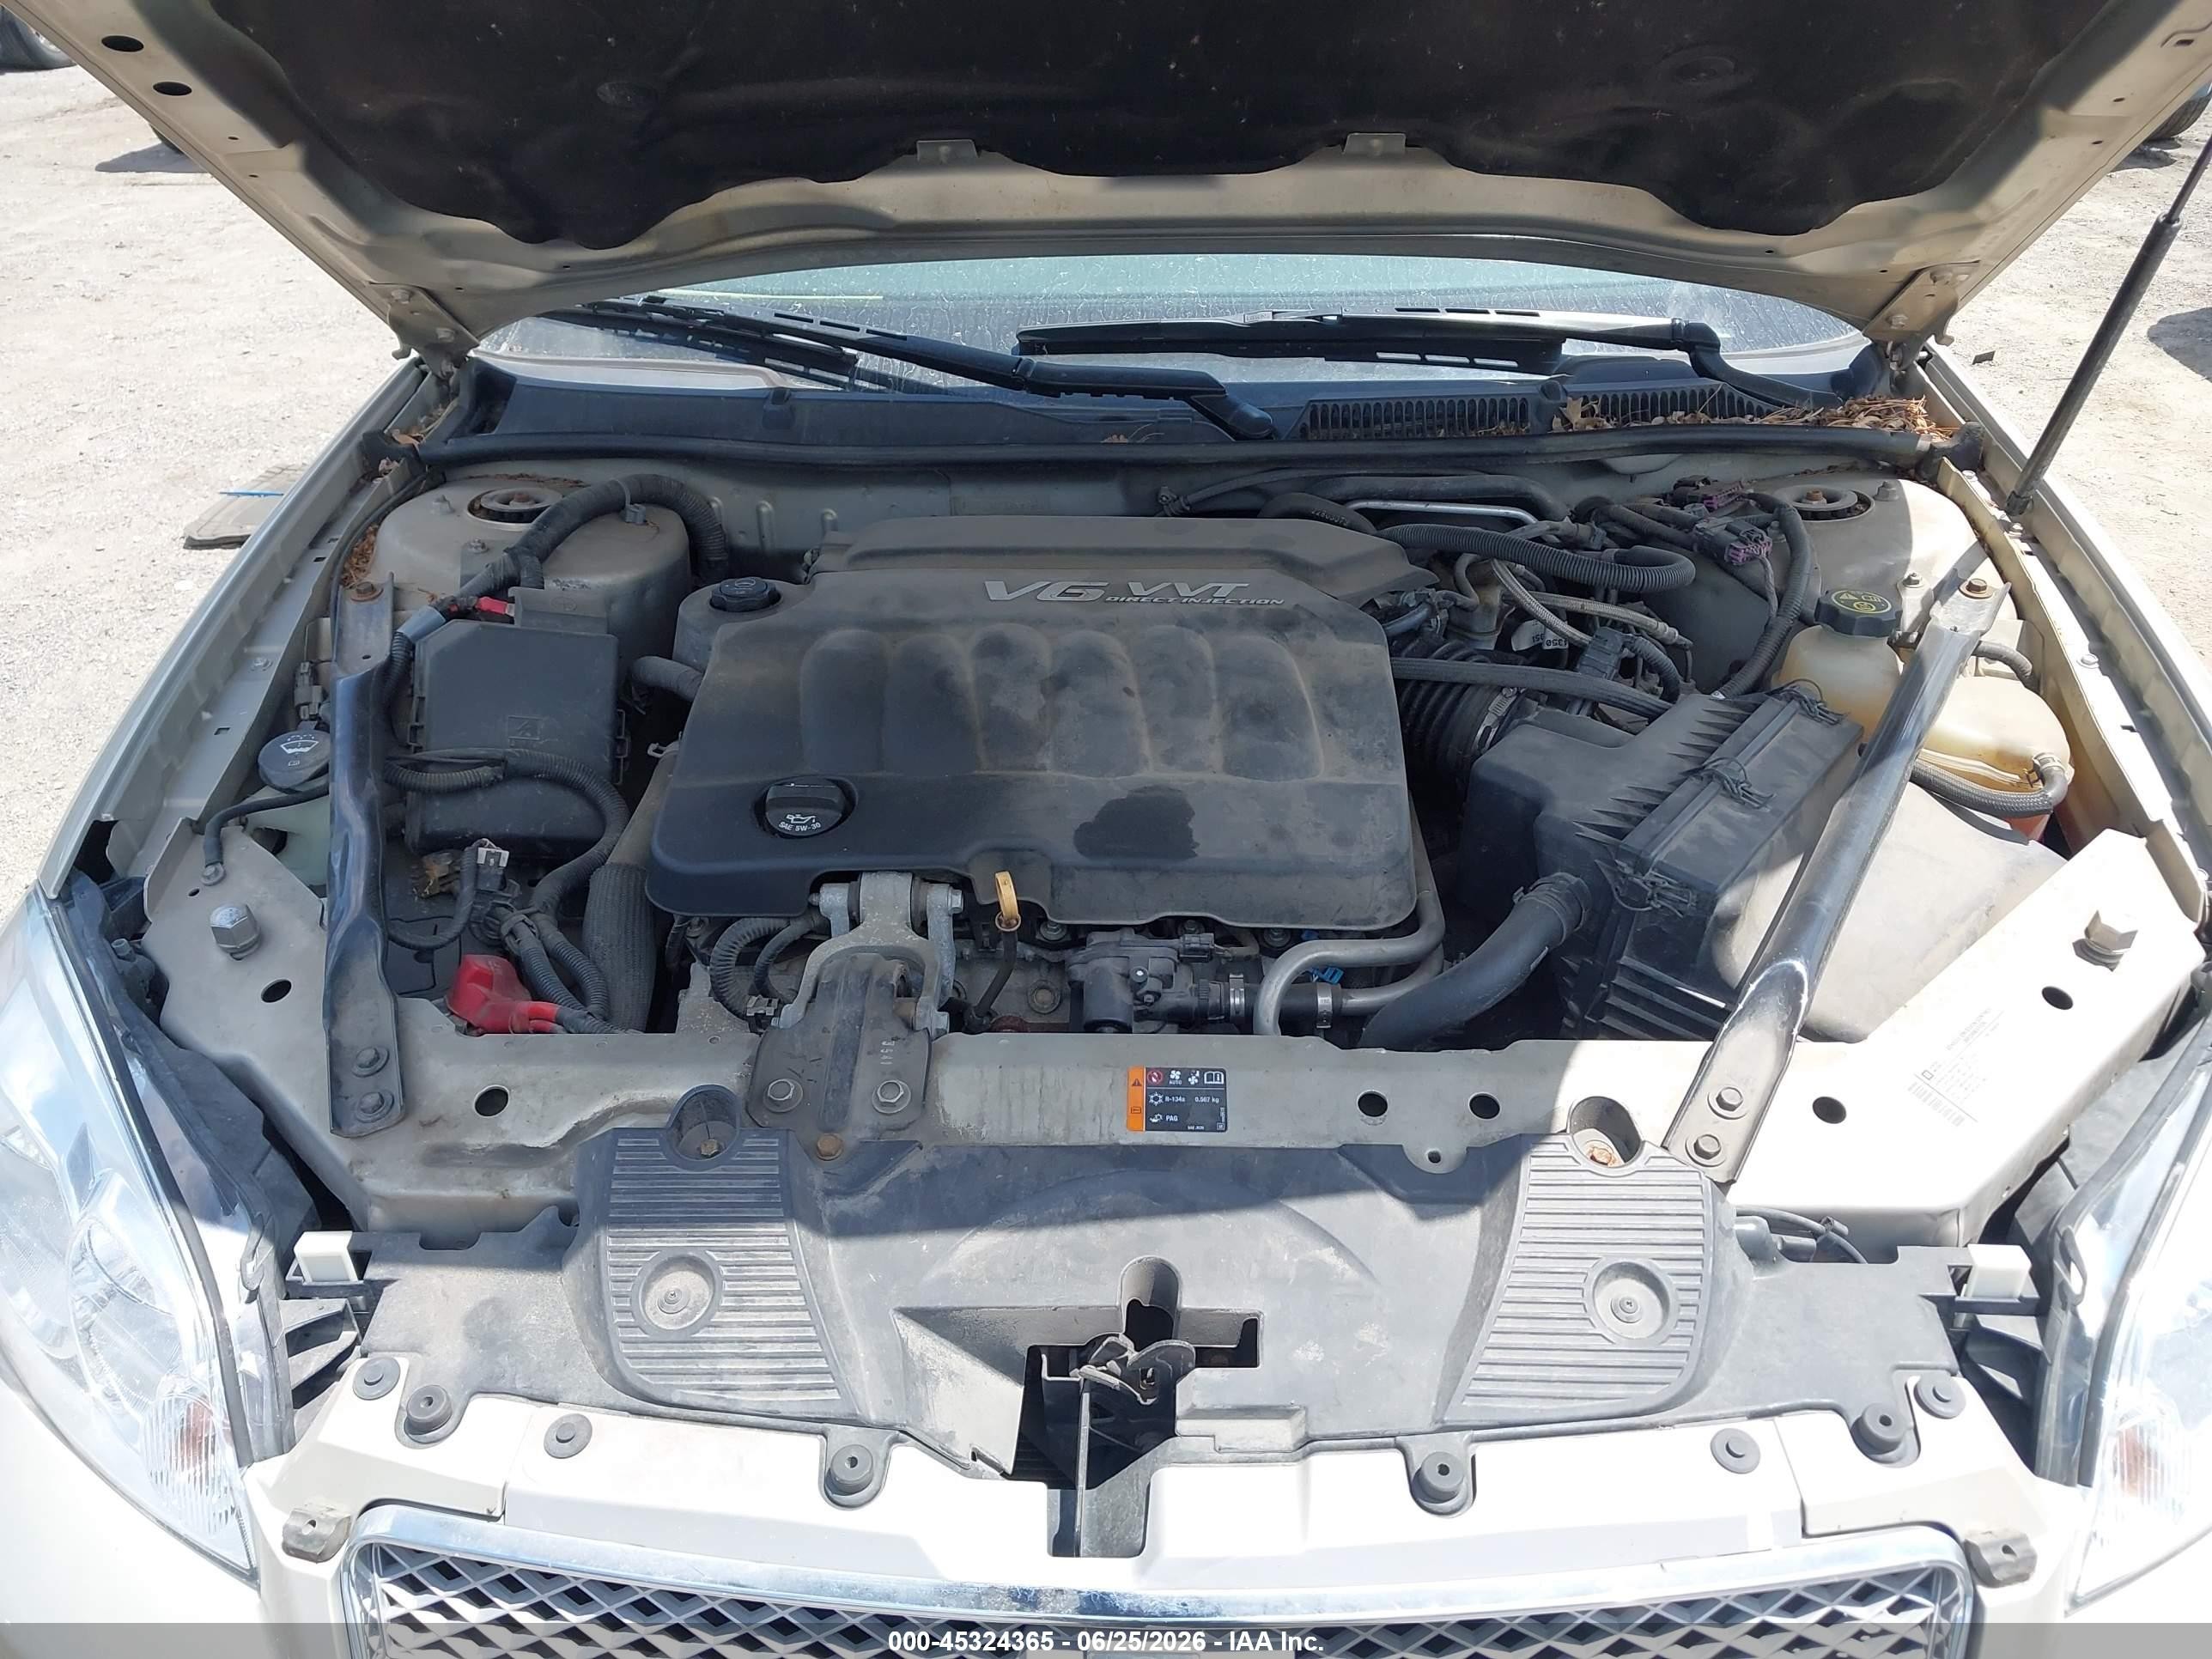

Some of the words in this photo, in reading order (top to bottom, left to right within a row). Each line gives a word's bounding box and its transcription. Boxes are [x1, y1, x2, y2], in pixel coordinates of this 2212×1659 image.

[985, 580, 1109, 601] V6
[1127, 582, 1249, 598] VVT
[779, 822, 793, 830] SAE
[795, 822, 821, 831] 5W-30
